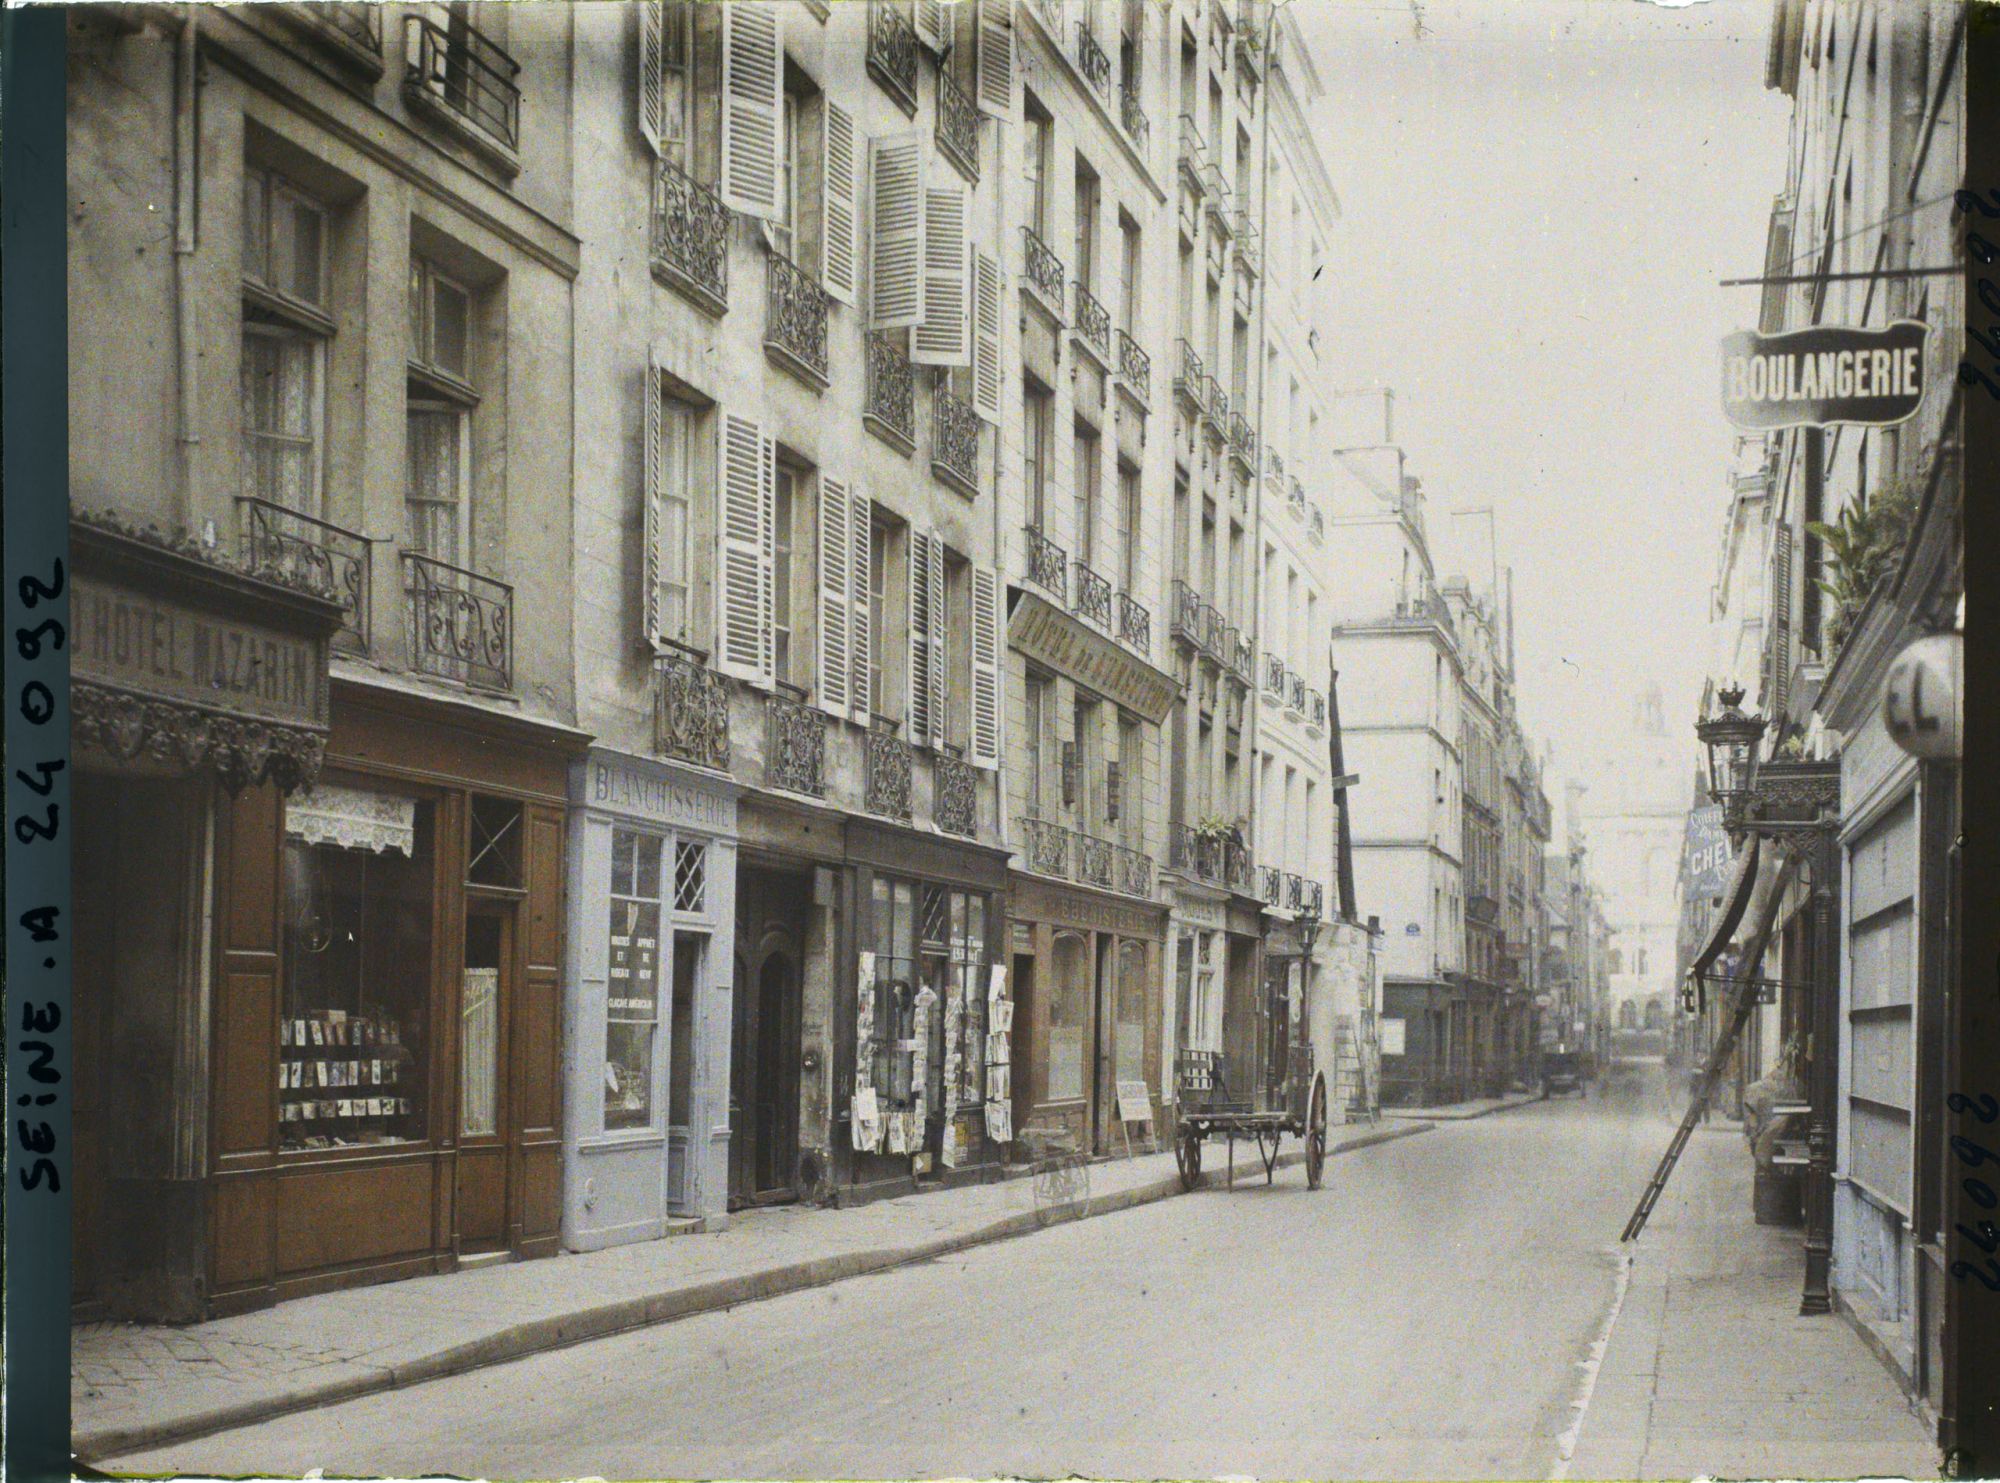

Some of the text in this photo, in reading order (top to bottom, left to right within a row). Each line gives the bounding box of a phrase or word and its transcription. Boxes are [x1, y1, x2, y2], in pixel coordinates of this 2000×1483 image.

[1728, 347, 1920, 402] BOULANGERIE
[94, 595, 182, 681] HOTEL
[193, 619, 312, 708] MAZARIN
[595, 763, 730, 828] BLANCHISSERIE
